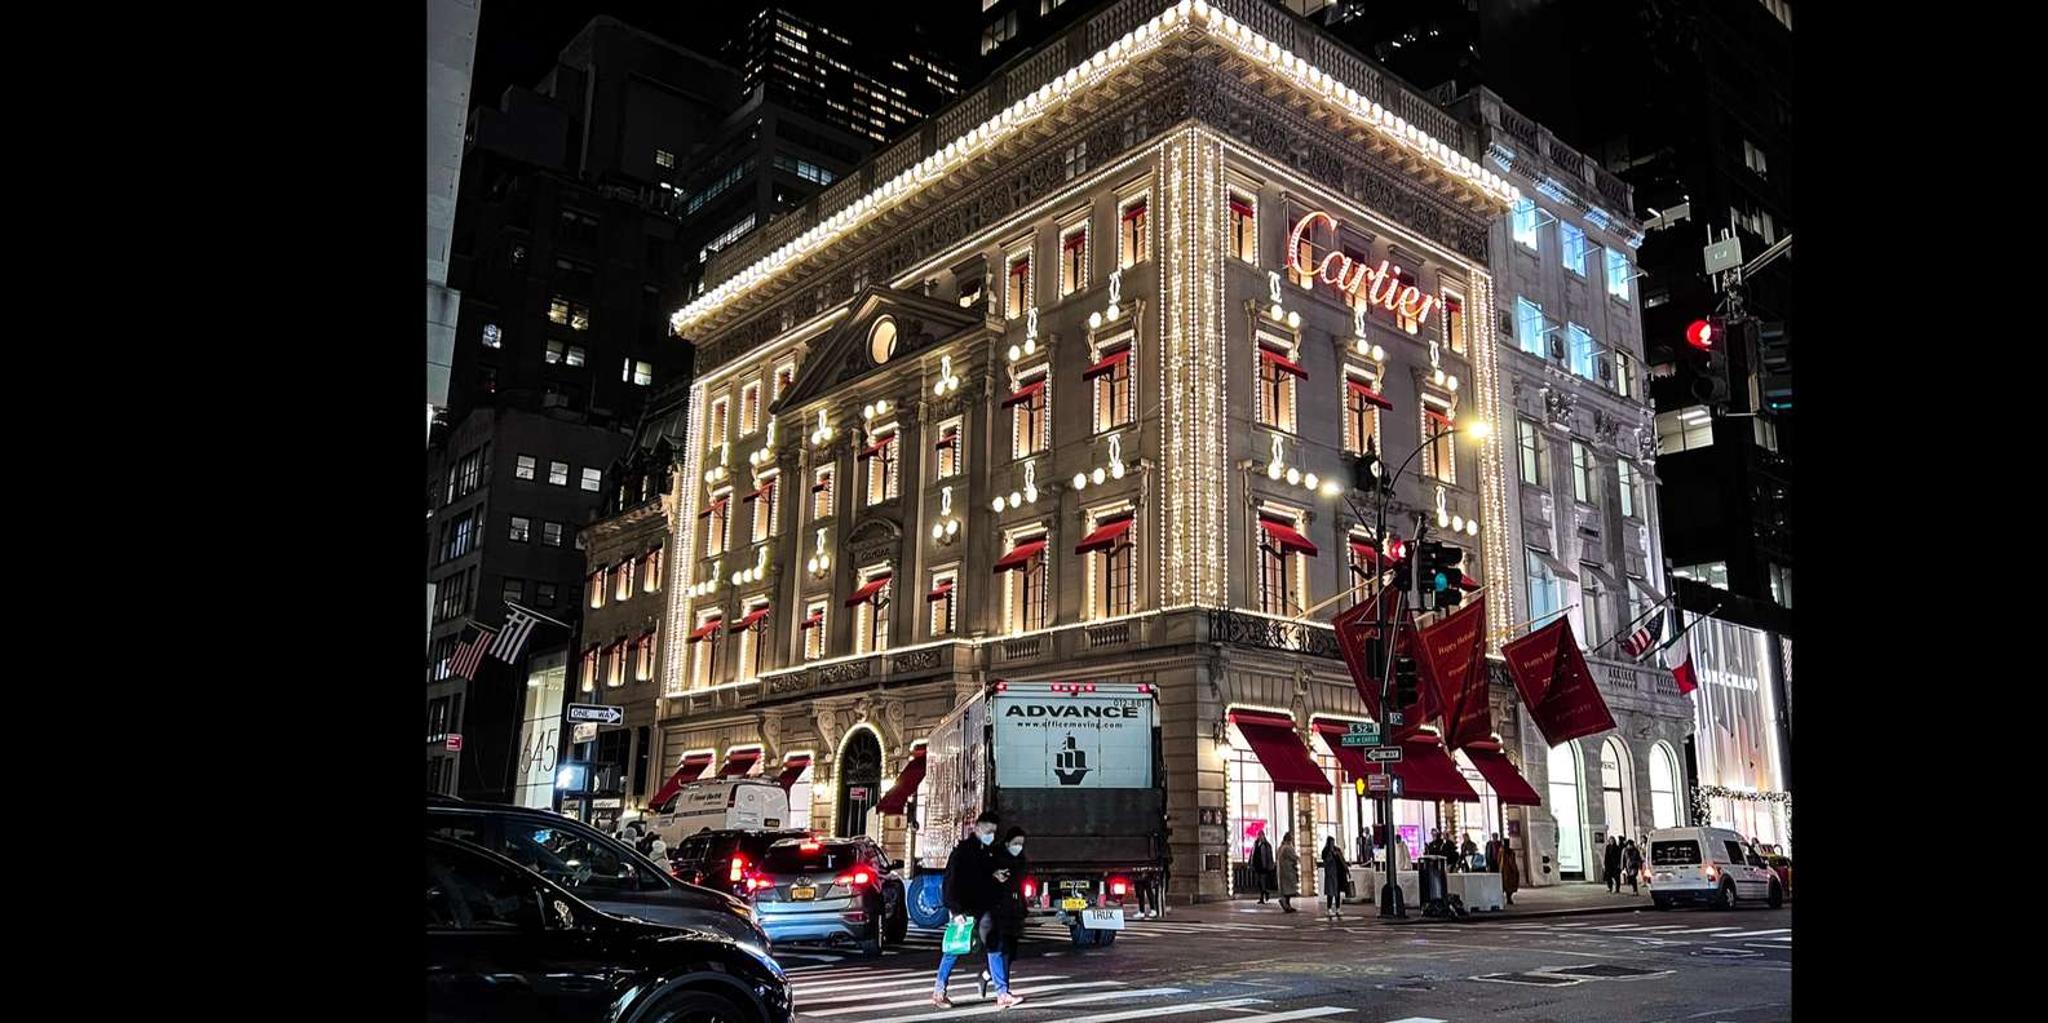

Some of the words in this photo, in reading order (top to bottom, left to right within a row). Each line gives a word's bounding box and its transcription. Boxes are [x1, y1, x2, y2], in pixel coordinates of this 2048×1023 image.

[1288, 211, 1442, 323] Cartier
[573, 709, 590, 717] ONE
[598, 711, 615, 719] WAY
[1005, 705, 1138, 718] ADVANCE
[521, 728, 557, 774] 645
